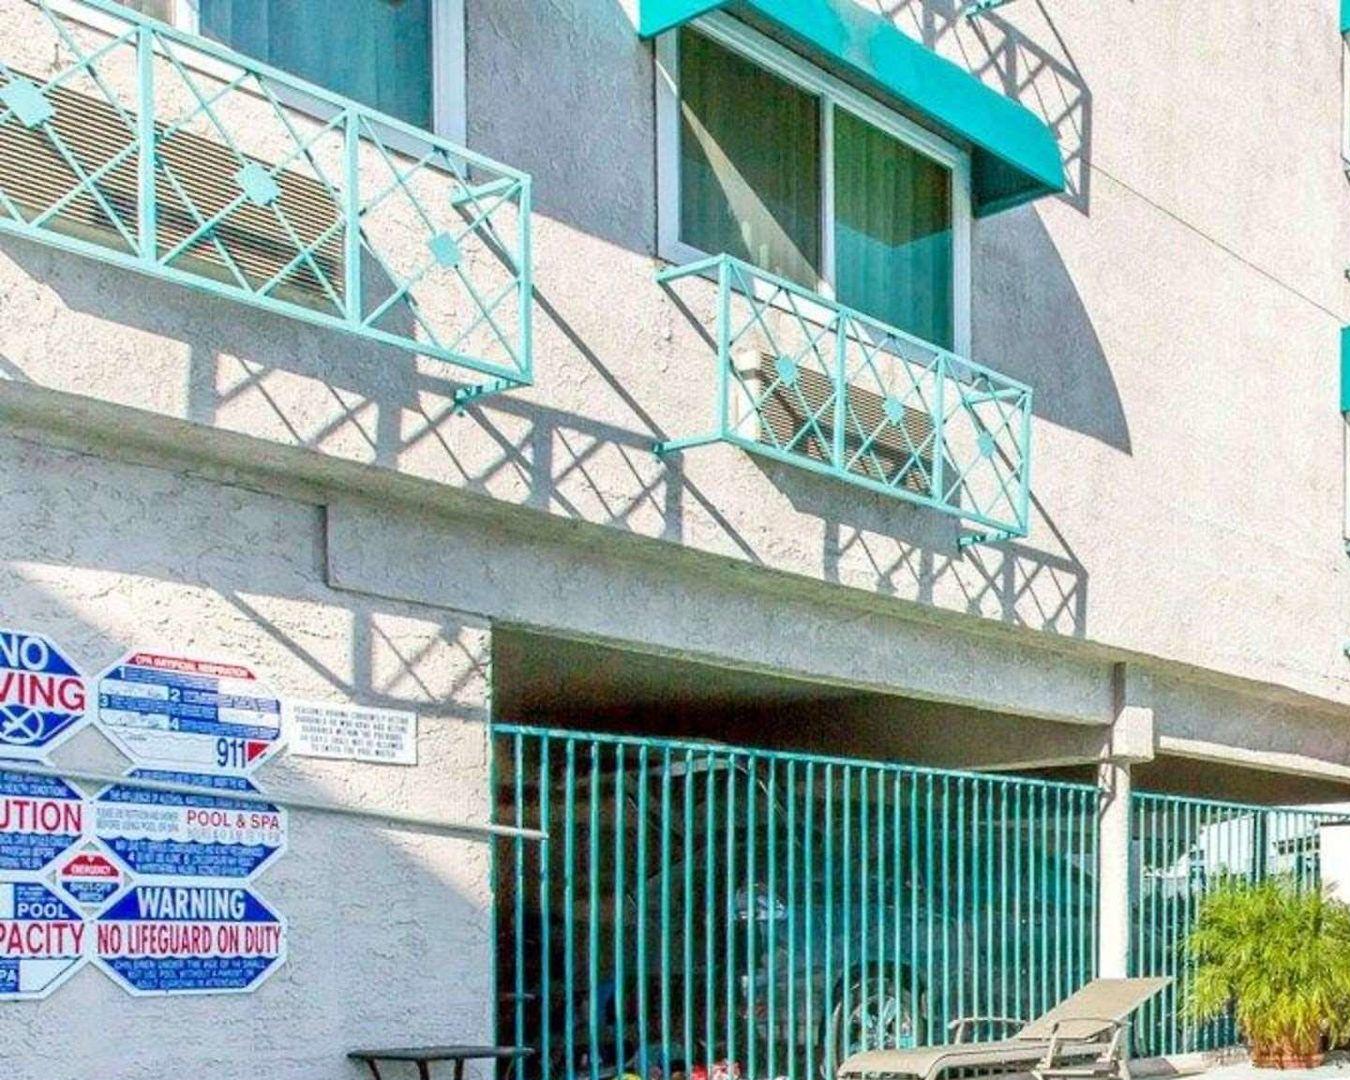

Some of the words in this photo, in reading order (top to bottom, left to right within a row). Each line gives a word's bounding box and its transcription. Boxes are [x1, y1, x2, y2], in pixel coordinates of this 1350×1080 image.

[0, 634, 48, 671] NO
[170, 688, 181, 701] 2
[169, 717, 180, 731] 4
[217, 737, 247, 769] 911
[187, 809, 232, 827] POOL
[235, 812, 246, 829] &
[250, 812, 280, 830] SPA
[17, 903, 69, 919] POOL
[137, 886, 246, 920] WARNING
[97, 924, 121, 954] NO
[127, 924, 212, 954] LIFEGUARD
[217, 925, 239, 954] ON
[245, 925, 282, 954] DUTY
